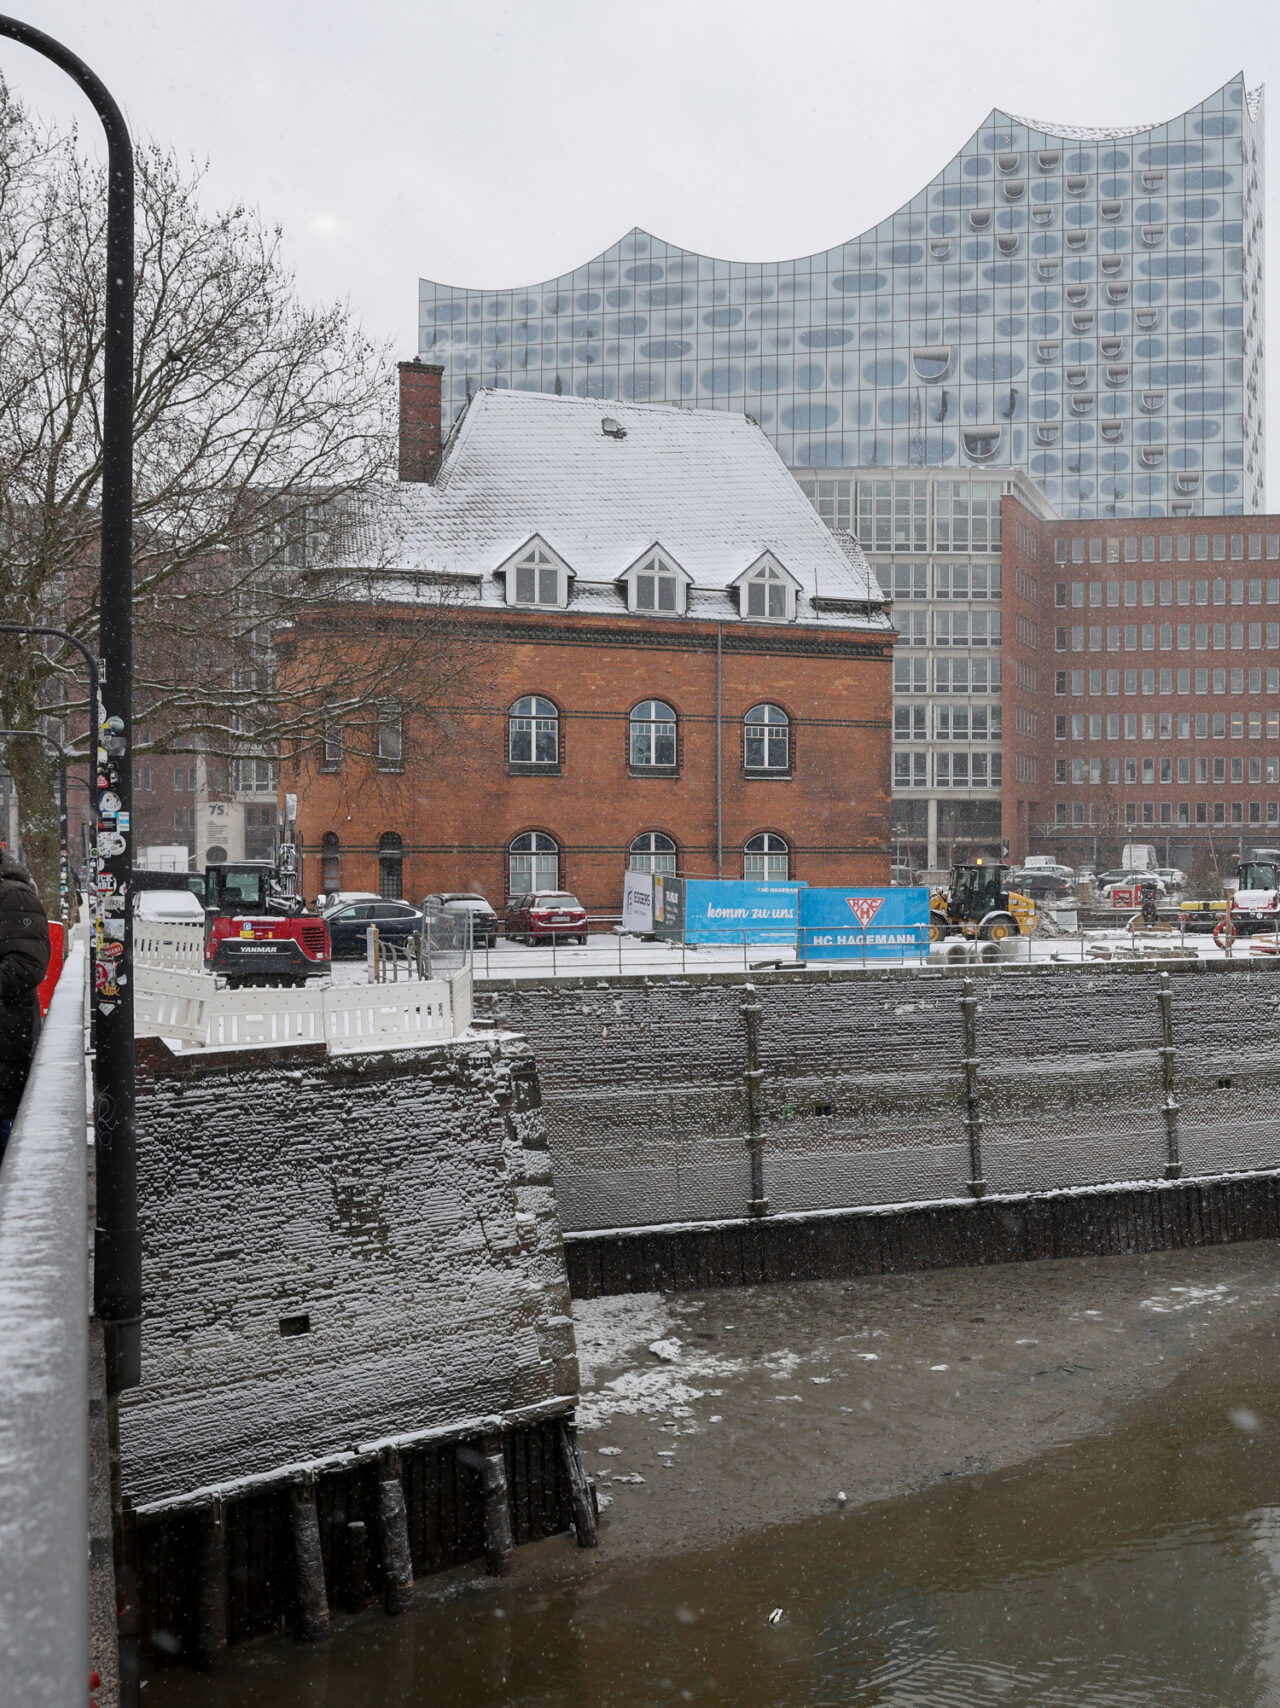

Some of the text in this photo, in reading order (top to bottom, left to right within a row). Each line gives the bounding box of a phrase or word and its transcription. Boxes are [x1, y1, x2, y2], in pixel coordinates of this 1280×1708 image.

[209, 804, 225, 815] 75
[707, 902, 749, 919] komm
[751, 907, 771, 919] zu
[771, 908, 794, 918] uns
[813, 934, 916, 945] HC HAGEMANN
